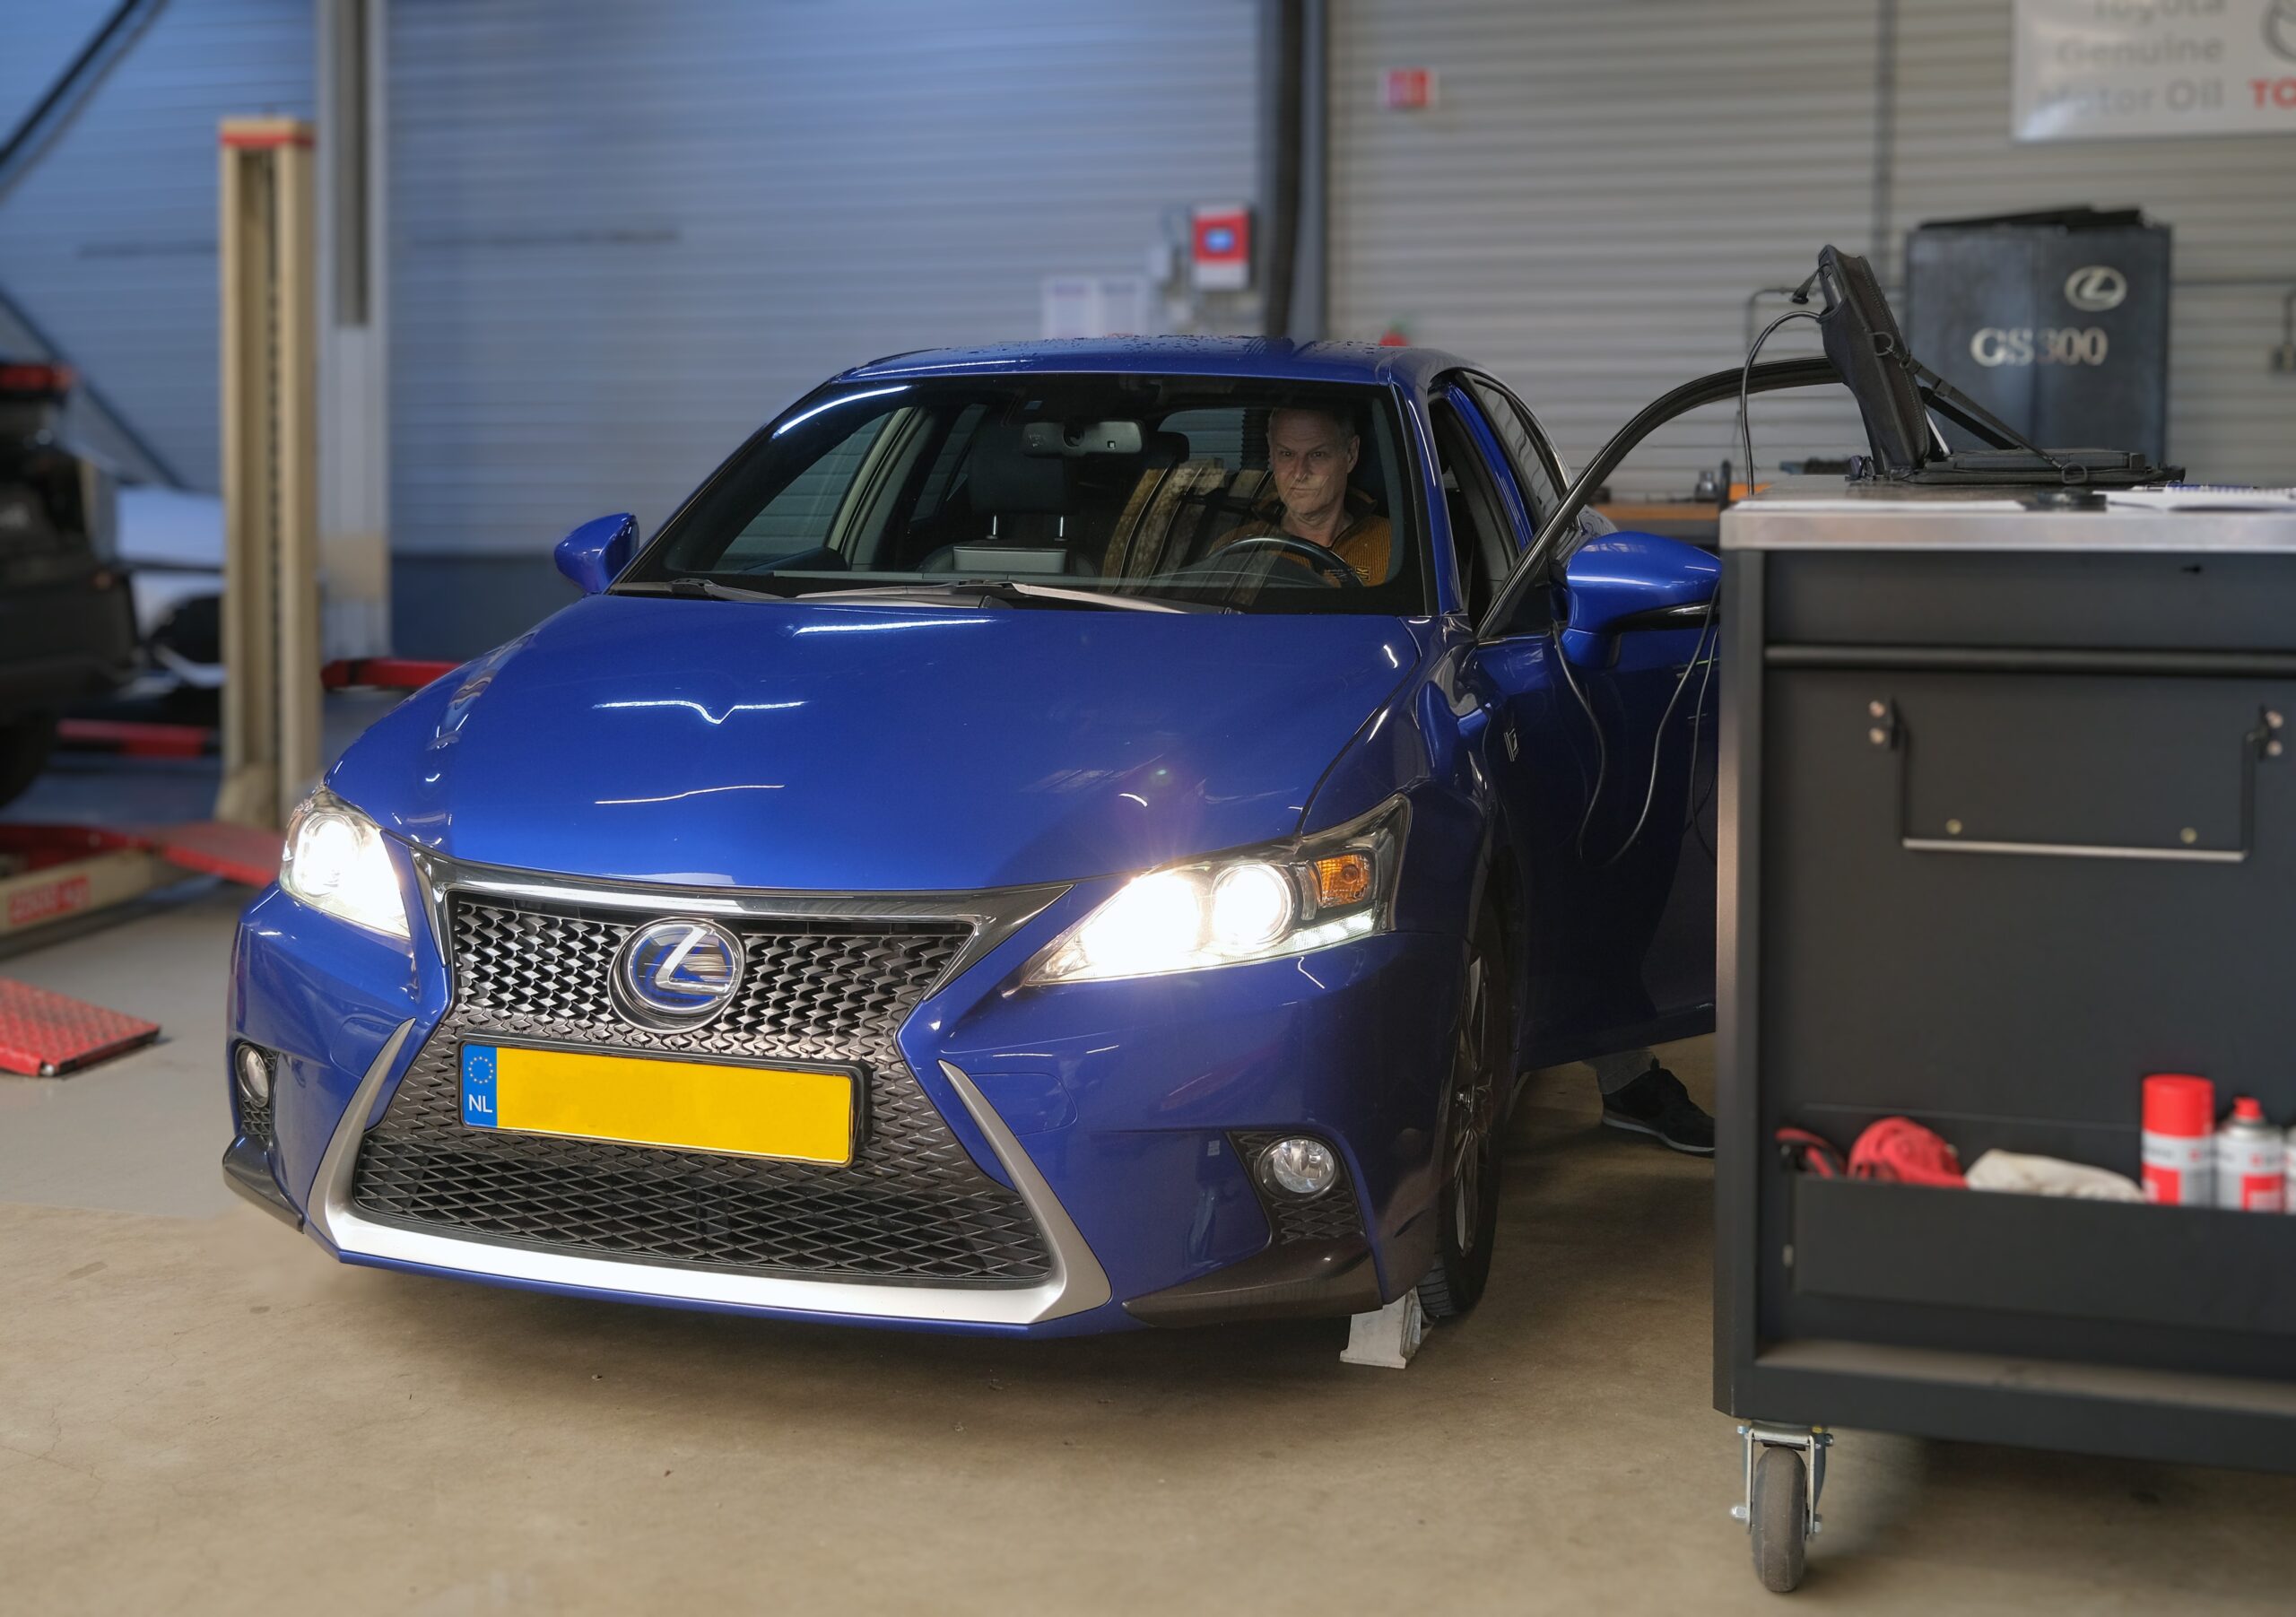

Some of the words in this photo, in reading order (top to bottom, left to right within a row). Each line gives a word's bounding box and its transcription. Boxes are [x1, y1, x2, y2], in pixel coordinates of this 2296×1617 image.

[2057, 33, 2224, 64] Genuine
[2165, 78, 2224, 112] Oil
[468, 1093, 493, 1113] NL
